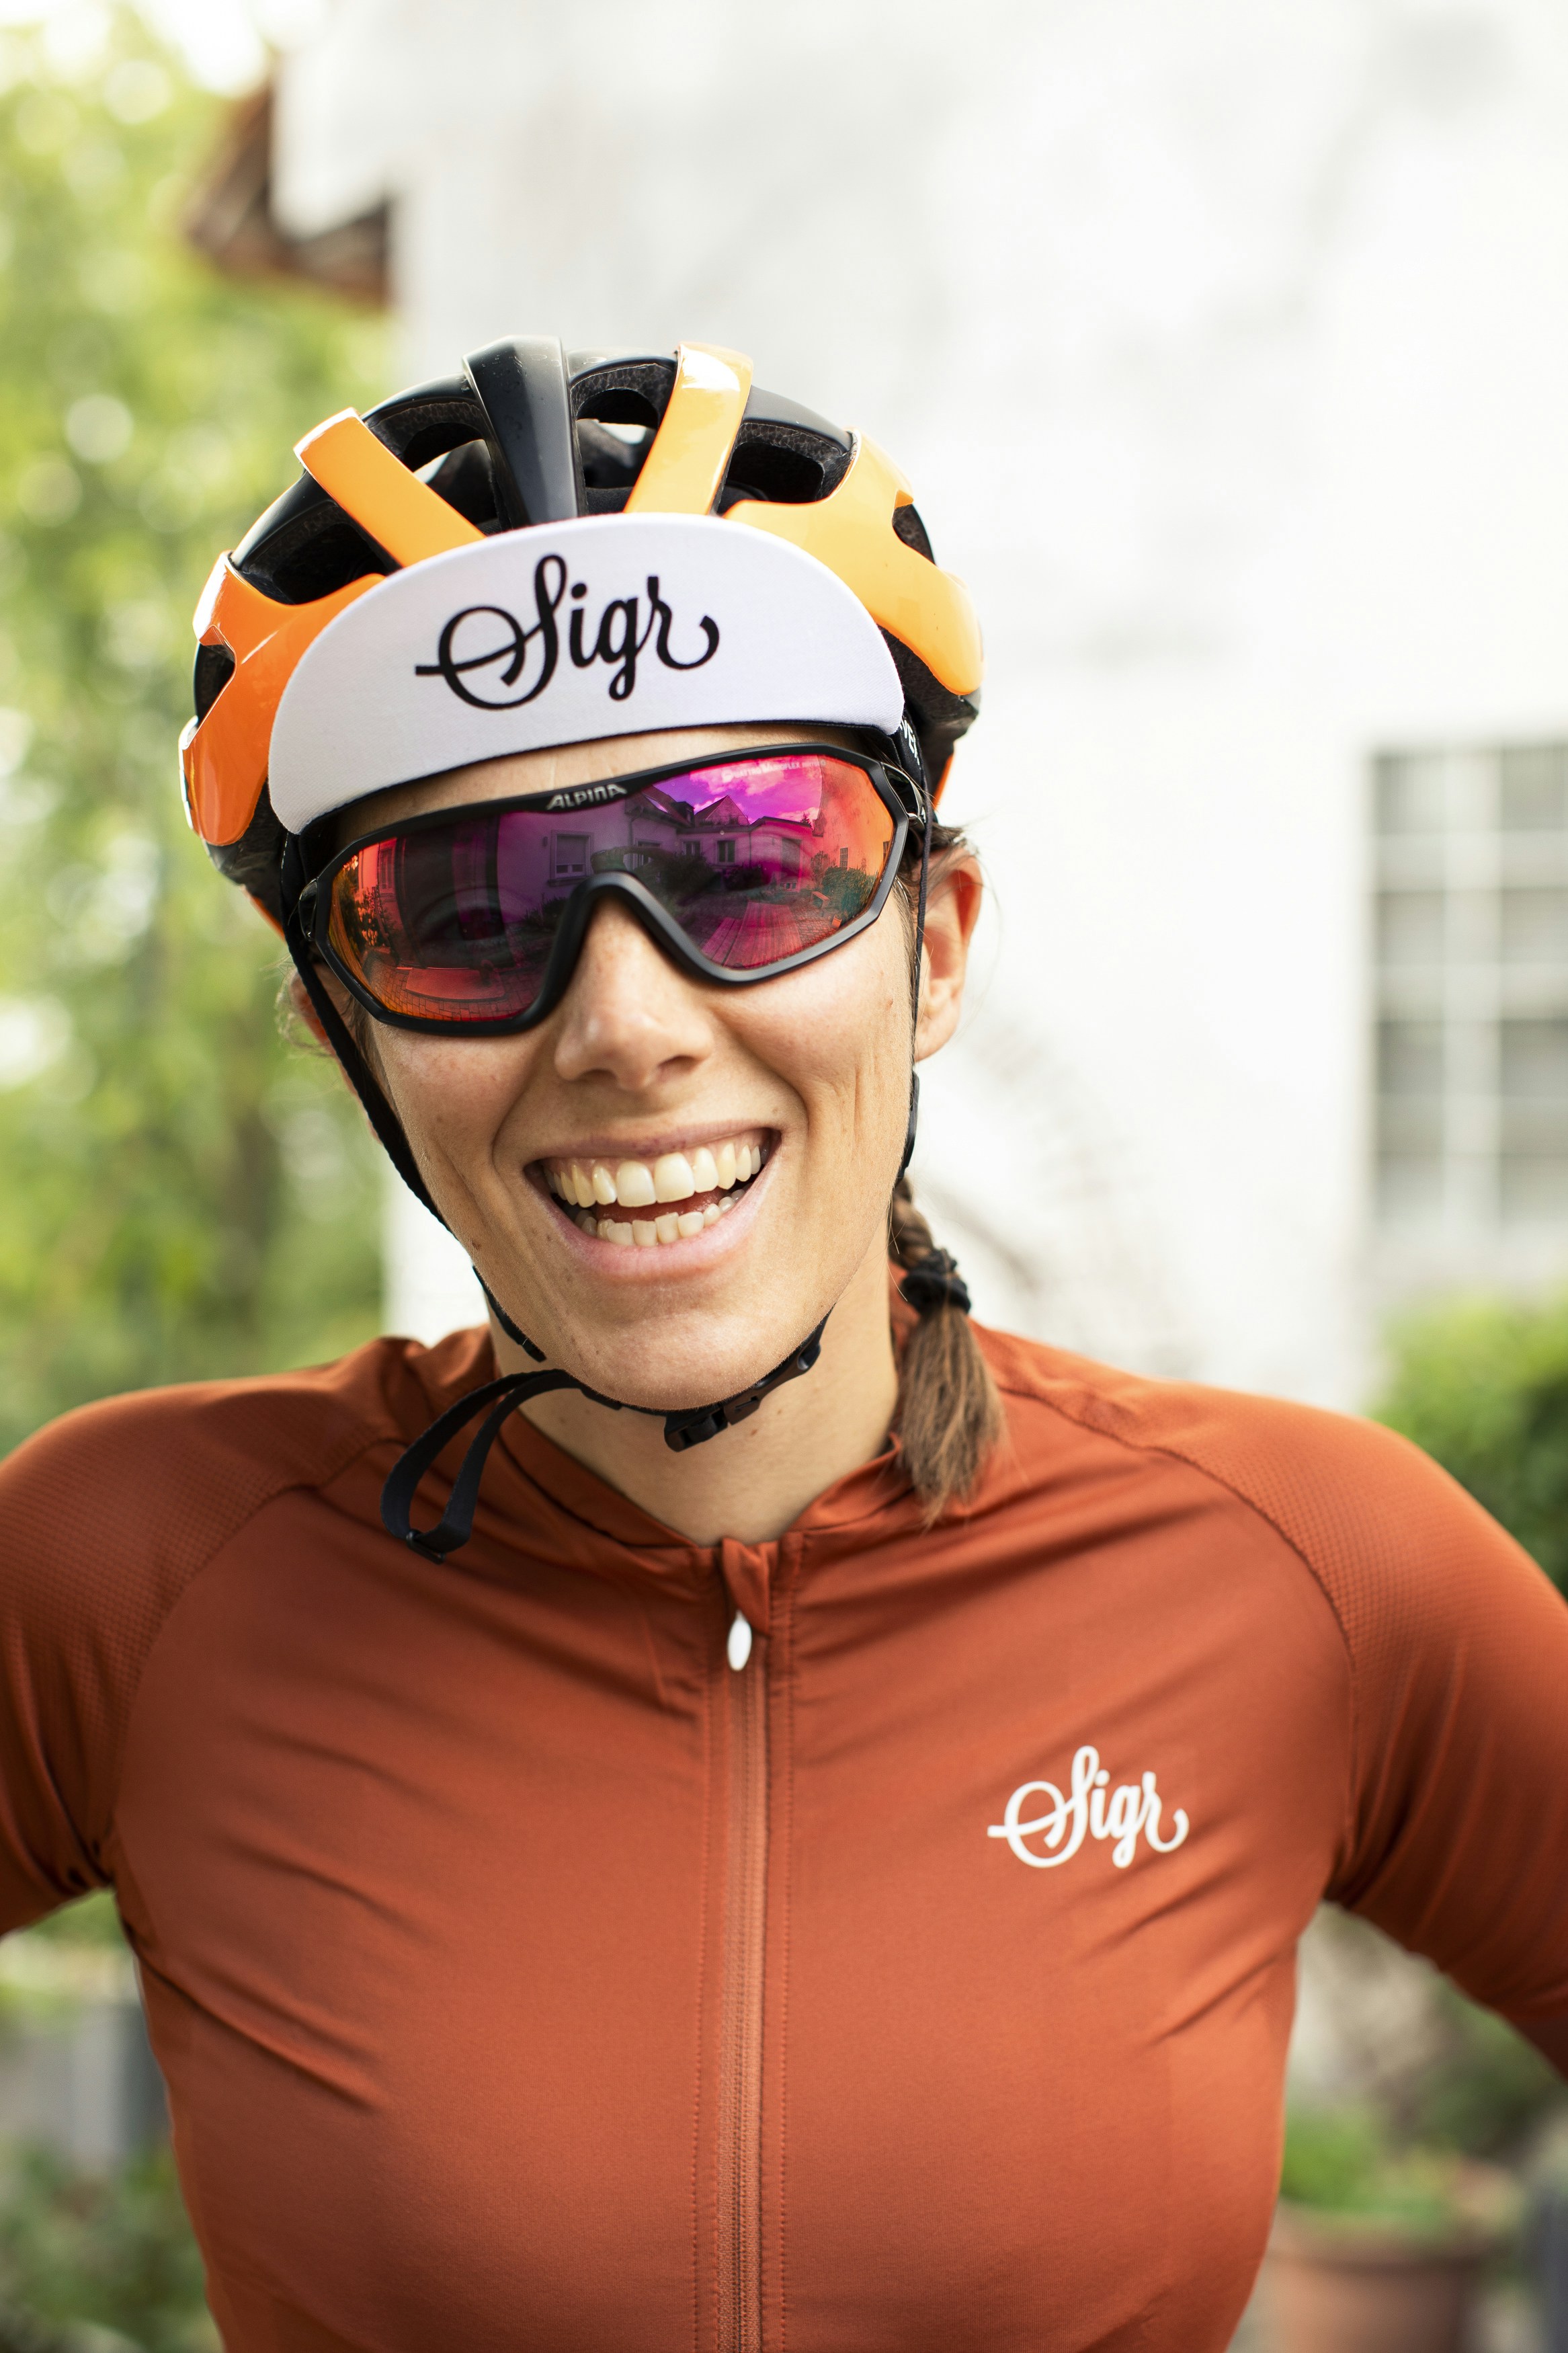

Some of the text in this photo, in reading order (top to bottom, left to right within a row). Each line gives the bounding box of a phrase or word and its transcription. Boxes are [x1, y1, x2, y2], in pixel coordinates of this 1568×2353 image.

[415, 553, 720, 710] Sigr
[546, 784, 627, 810] ALPINA
[987, 1745, 1189, 1868] Sigr
